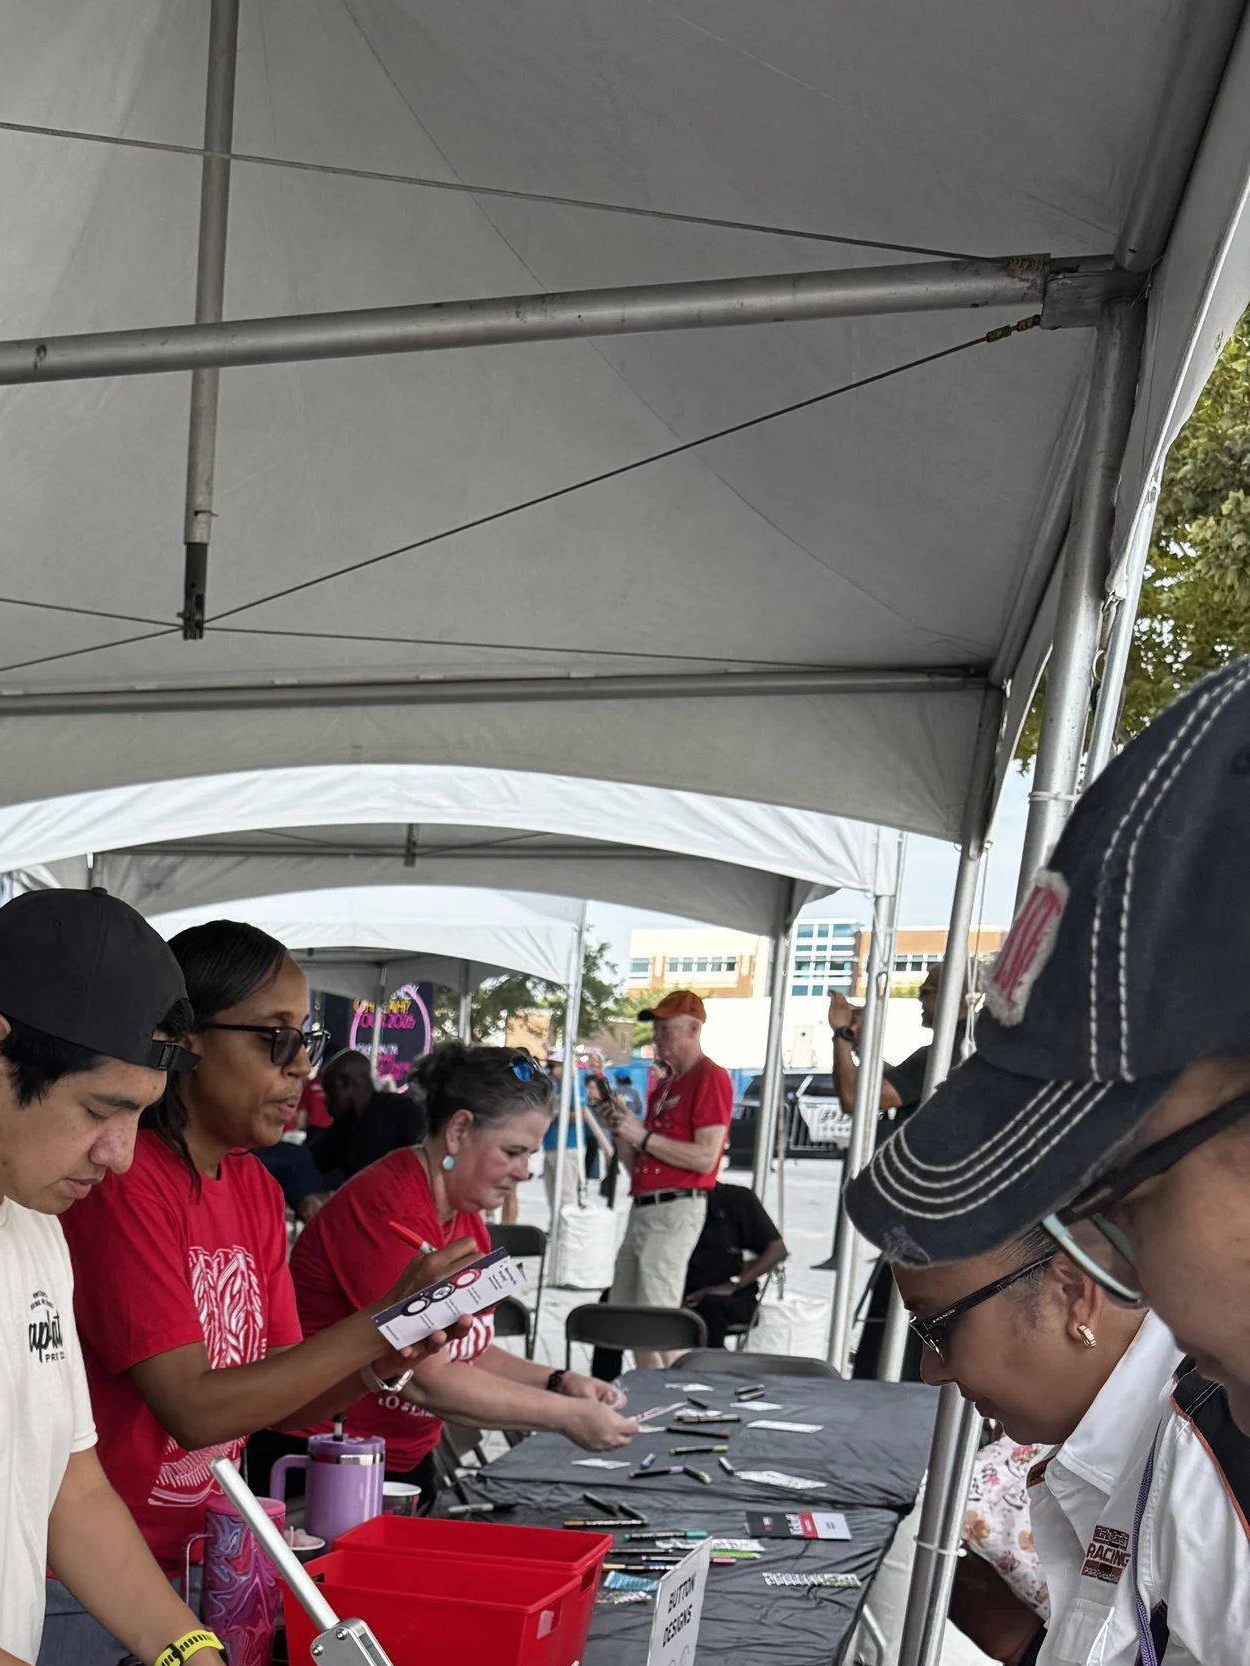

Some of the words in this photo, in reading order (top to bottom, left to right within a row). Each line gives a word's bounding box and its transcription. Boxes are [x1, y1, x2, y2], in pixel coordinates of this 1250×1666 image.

[1086, 1543, 1131, 1567] RACING
[668, 1571, 696, 1614] BUTTON
[662, 1604, 694, 1648] DESIGNS
